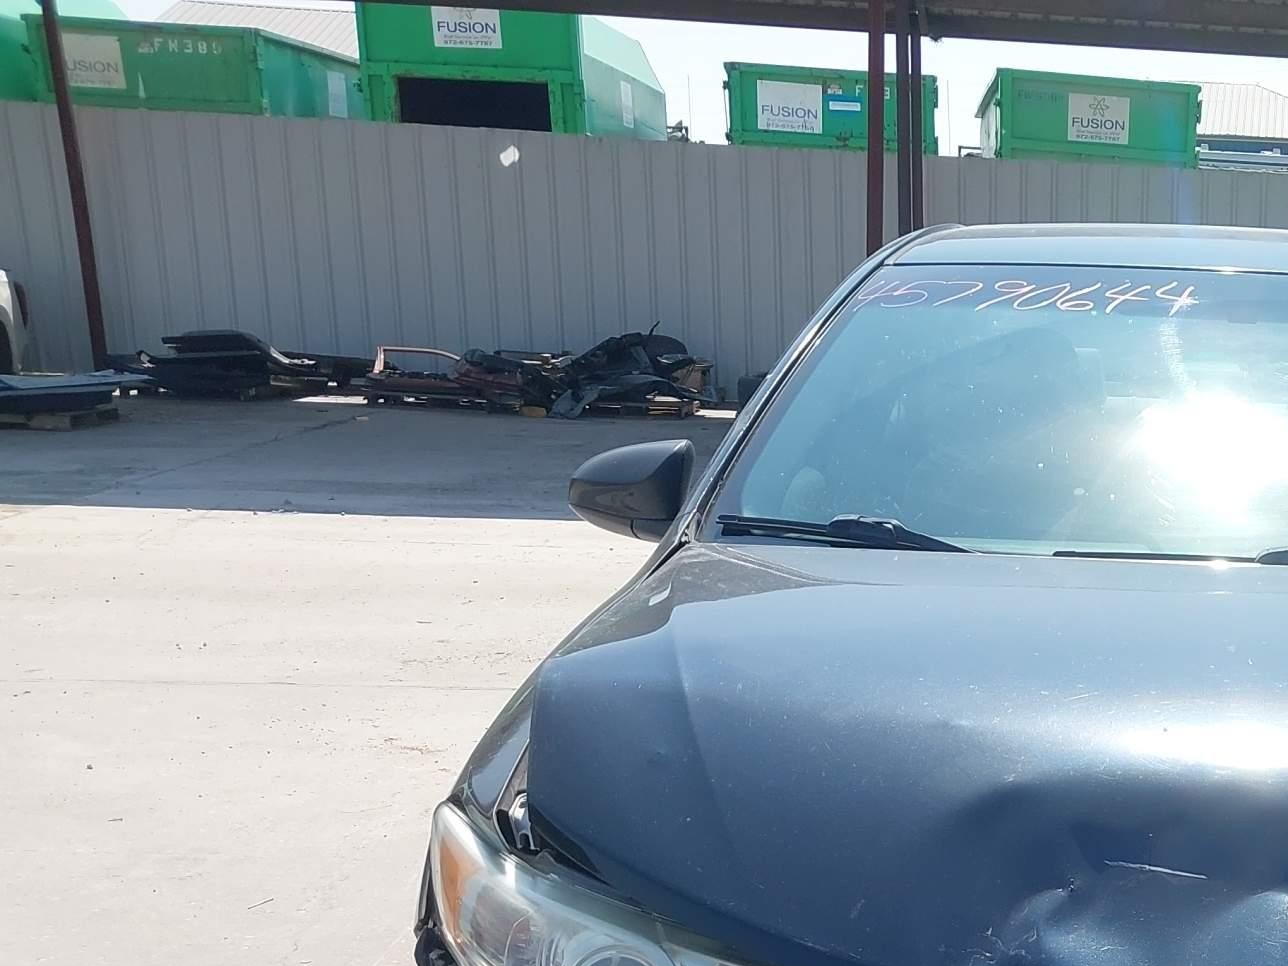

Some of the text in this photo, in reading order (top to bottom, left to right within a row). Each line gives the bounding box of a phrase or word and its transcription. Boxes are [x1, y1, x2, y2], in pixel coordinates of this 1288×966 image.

[437, 20, 497, 34] FUSION
[66, 59, 119, 73] USION
[761, 104, 818, 120] FUSION
[1071, 116, 1125, 131] FUSION
[853, 280, 1200, 316] 45790644
